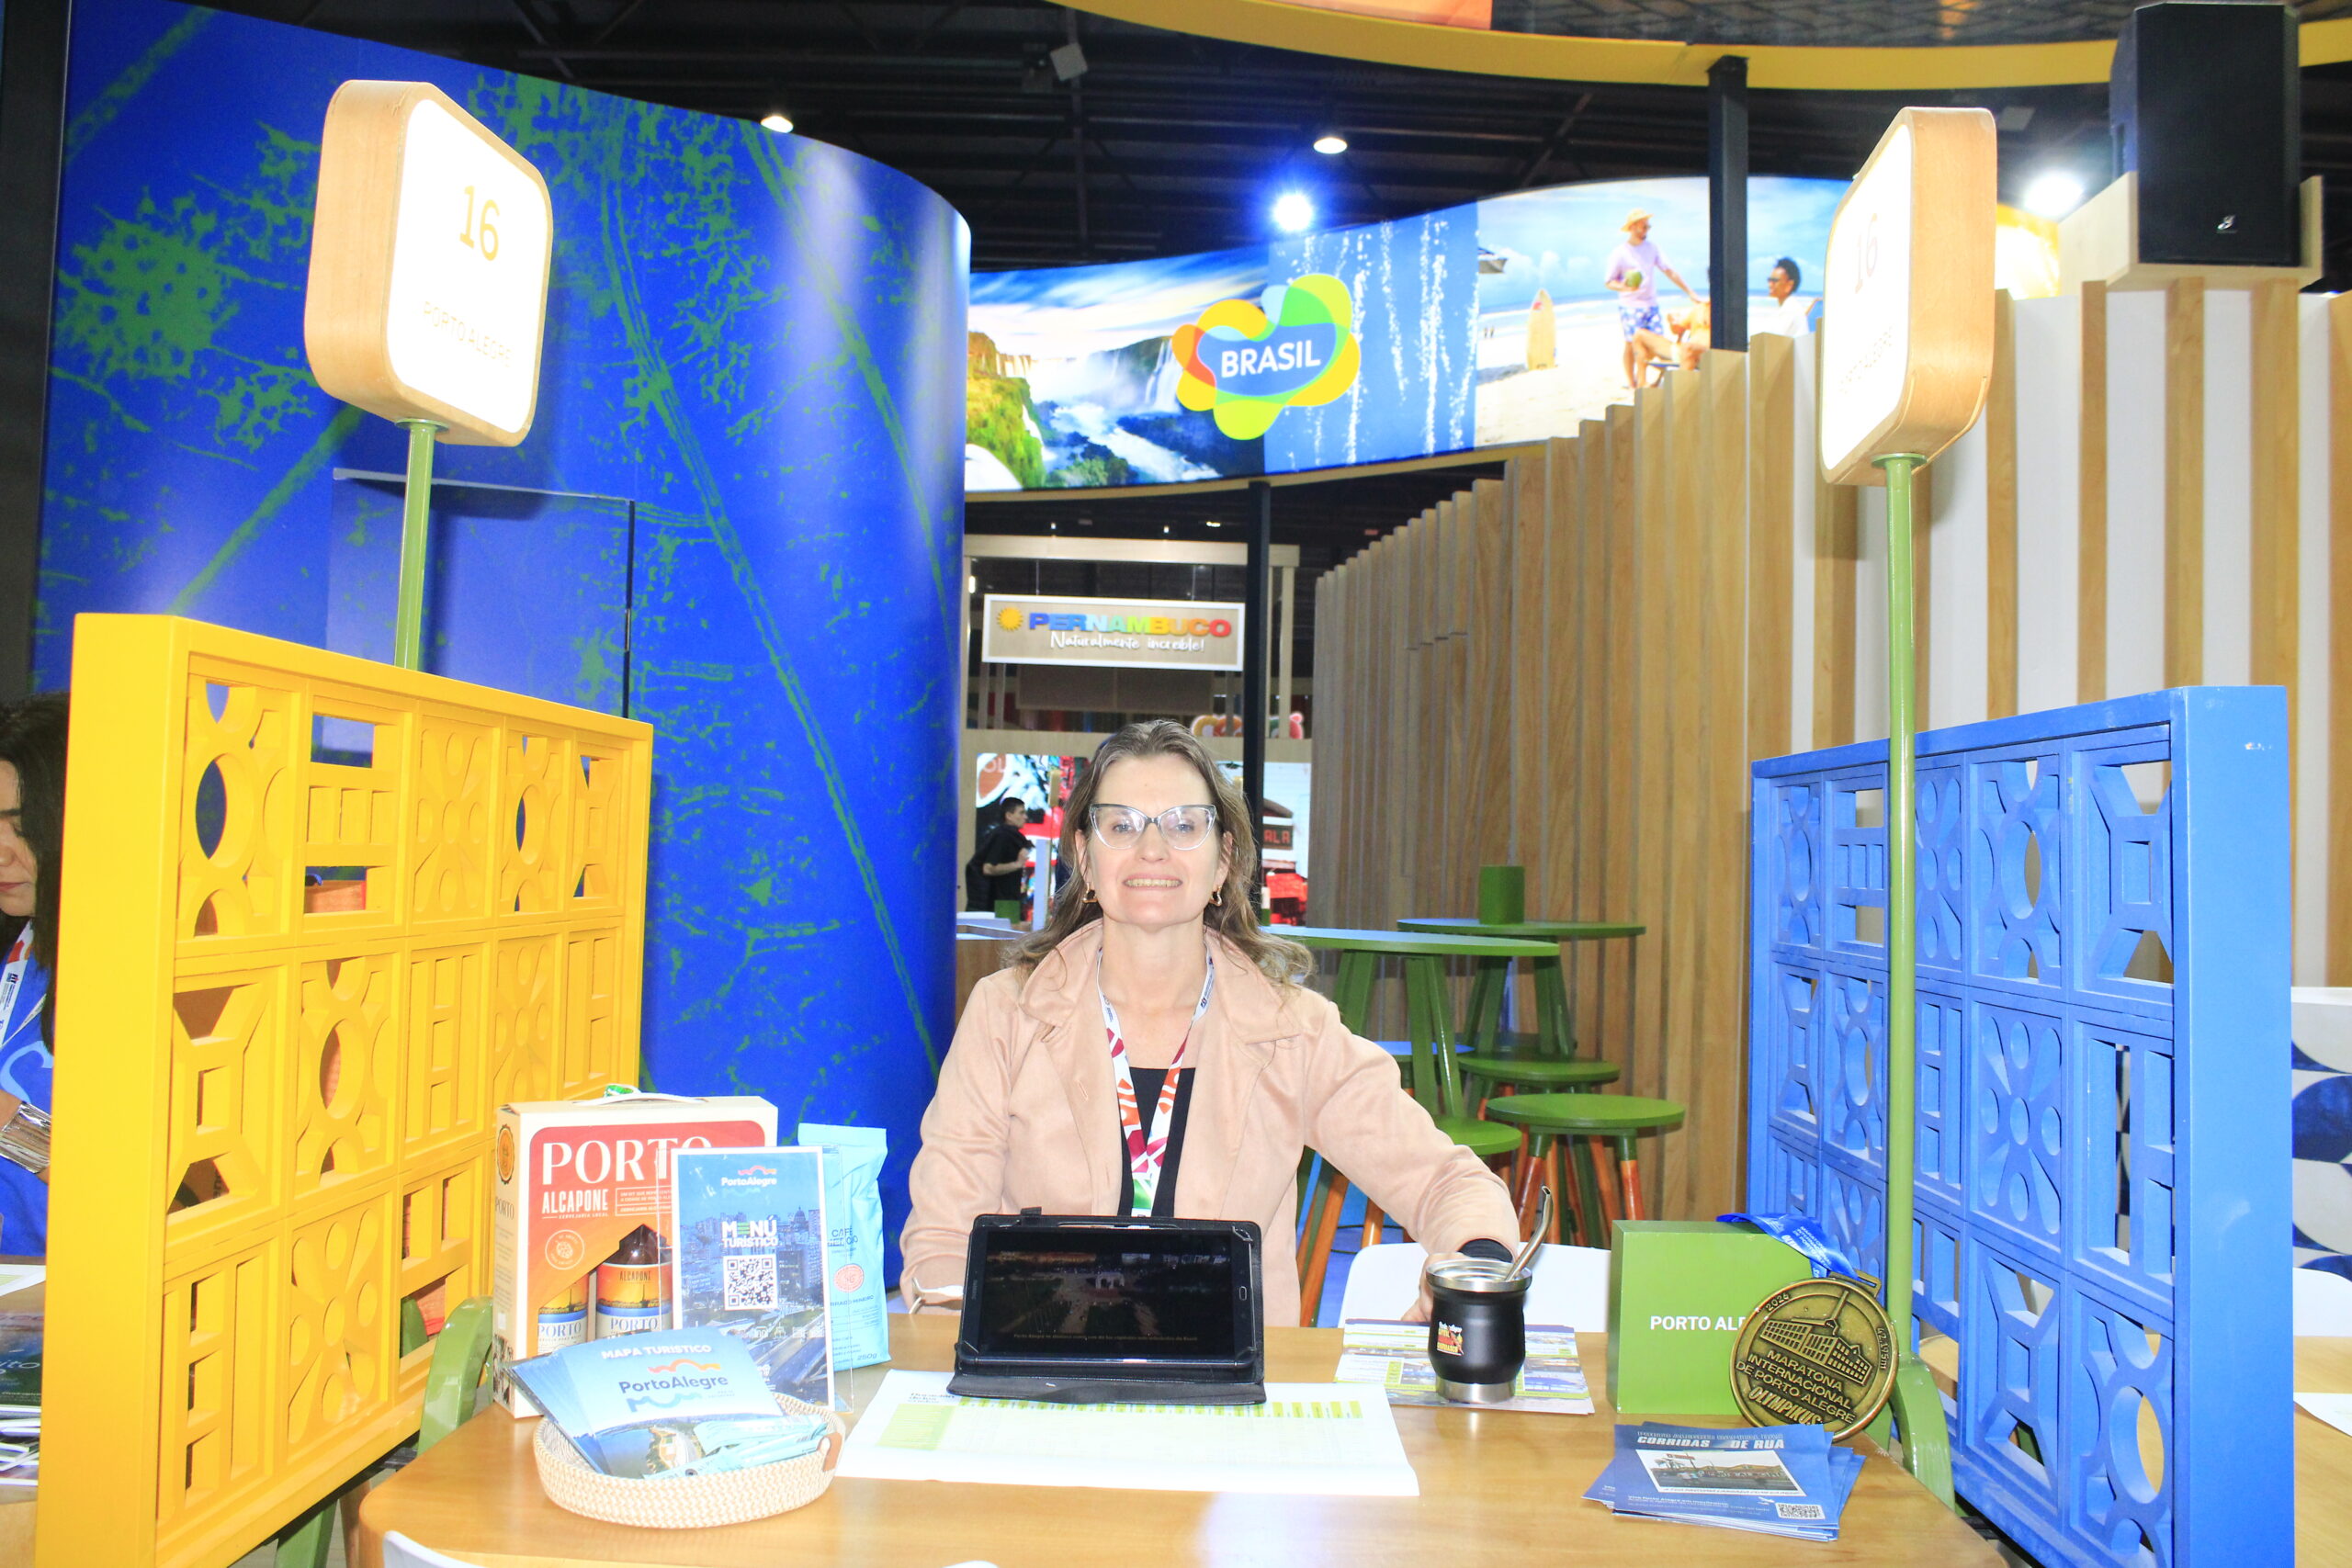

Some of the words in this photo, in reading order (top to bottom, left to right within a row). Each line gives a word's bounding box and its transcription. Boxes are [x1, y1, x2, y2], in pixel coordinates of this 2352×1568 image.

[459, 185, 500, 261] 16
[1855, 212, 1878, 294] 16
[423, 300, 466, 342] PORTO
[1221, 340, 1321, 378] BRASIL
[1029, 612, 1232, 637] PERNAMBUCO
[1050, 631, 1140, 649] Naturalmente
[542, 1136, 711, 1185] PORT
[721, 1177, 777, 1187] PortoAlegre
[541, 1189, 609, 1213] ALCAPONE
[721, 1215, 777, 1237] MENÚ
[538, 1321, 582, 1337] PORTO
[610, 1317, 658, 1332] PORTO
[1650, 1315, 1711, 1330] PORTO
[601, 1348, 642, 1359] MAPA
[1747, 1353, 1851, 1410] INTERNACIONAL
[1767, 1349, 1844, 1393] MARATONA
[618, 1376, 729, 1393] PortoAlegre
[1736, 1360, 1755, 1375] DE
[1754, 1370, 1801, 1397] PORTO
[1801, 1393, 1856, 1424] ALEGRE
[1637, 1436, 1711, 1448] CORRIDAS
[1731, 1439, 1749, 1449] DE
[1753, 1438, 1785, 1449] RUA
